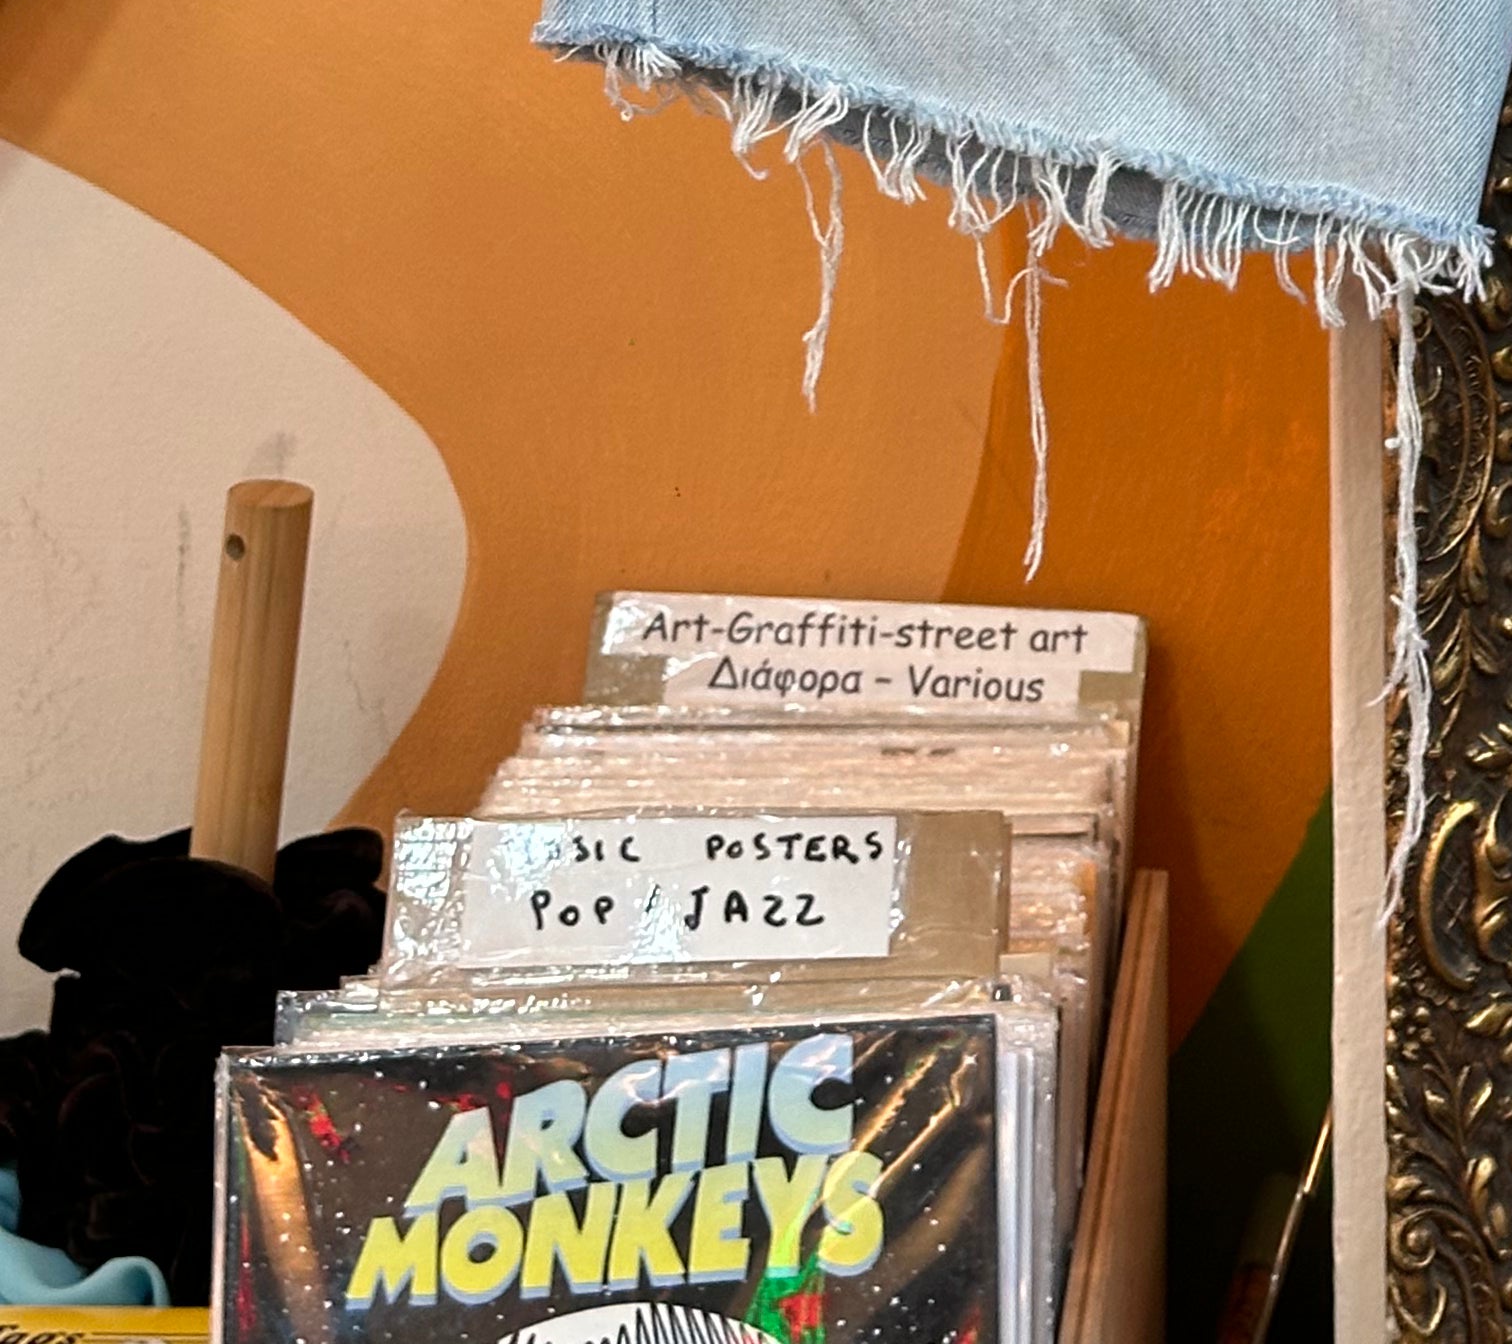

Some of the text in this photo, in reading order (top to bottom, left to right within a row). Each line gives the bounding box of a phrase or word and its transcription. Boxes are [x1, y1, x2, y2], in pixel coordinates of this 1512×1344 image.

[642, 612, 1088, 655] Art-Graffiti-street art
[707, 655, 861, 700] Διάφορα
[908, 665, 1044, 702] Various
[706, 833, 884, 865] POSTERS
[530, 889, 615, 931] POP
[684, 886, 825, 931] JAZZ
[403, 1032, 855, 1219] ARCTIC
[345, 1150, 885, 1312] MONKEYS
